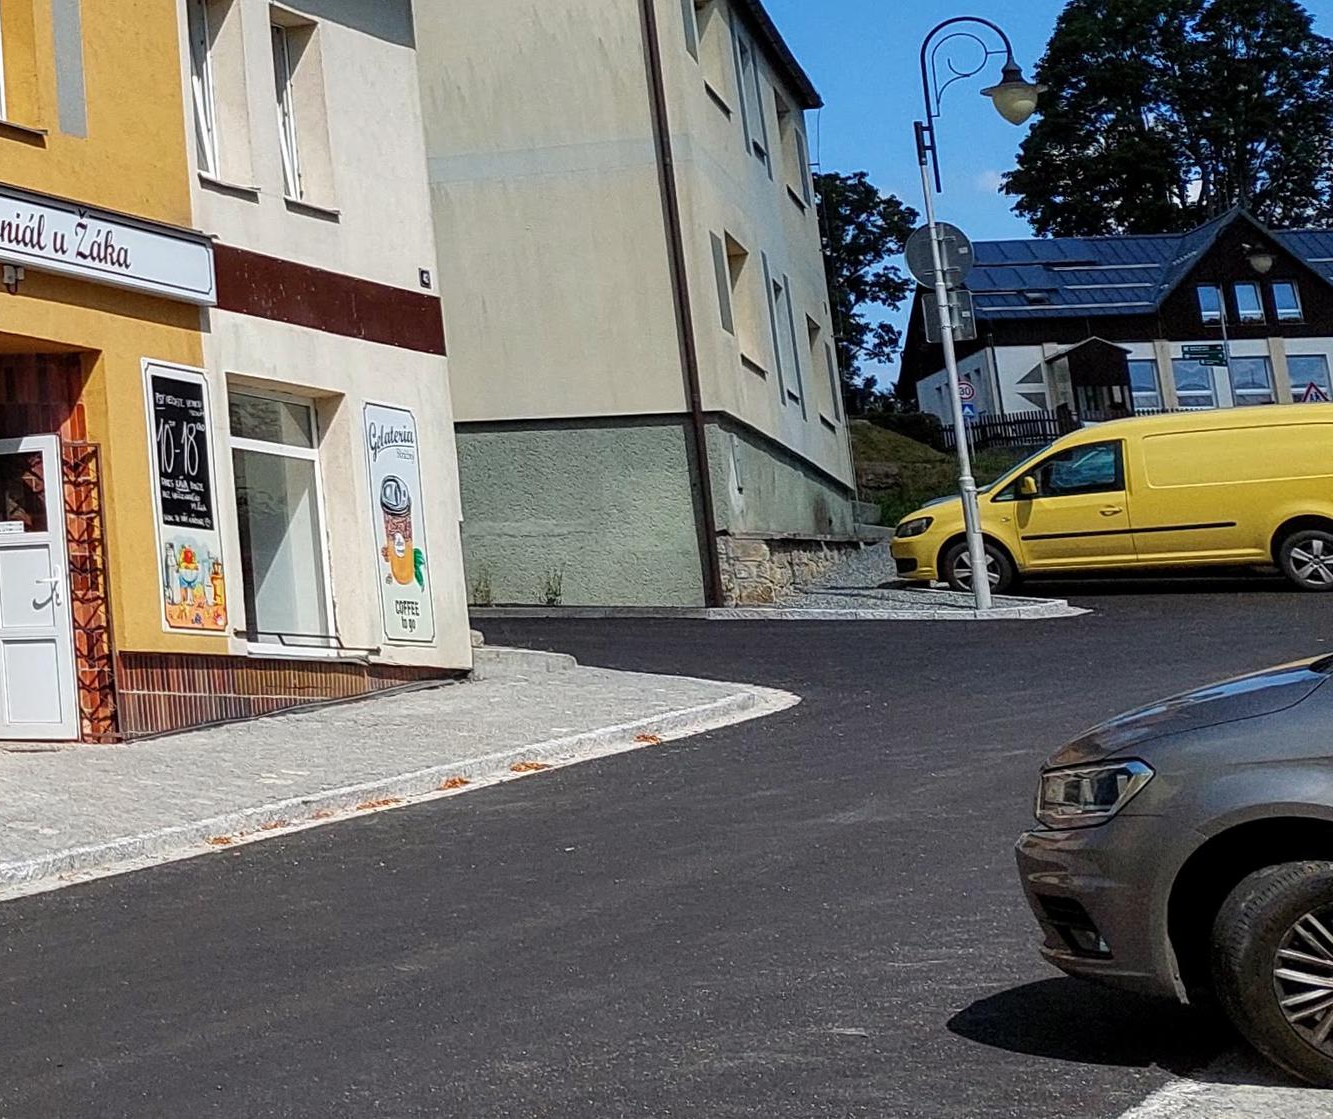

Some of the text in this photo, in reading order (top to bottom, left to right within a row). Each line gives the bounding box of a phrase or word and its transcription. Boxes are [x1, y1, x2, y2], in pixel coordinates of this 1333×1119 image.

[53, 231, 68, 255] u
[74, 208, 132, 270] Žáka
[959, 387, 972, 396] 30
[369, 422, 414, 462] Gelateria
[395, 600, 420, 616] COFFEE
[409, 619, 416, 632] go
